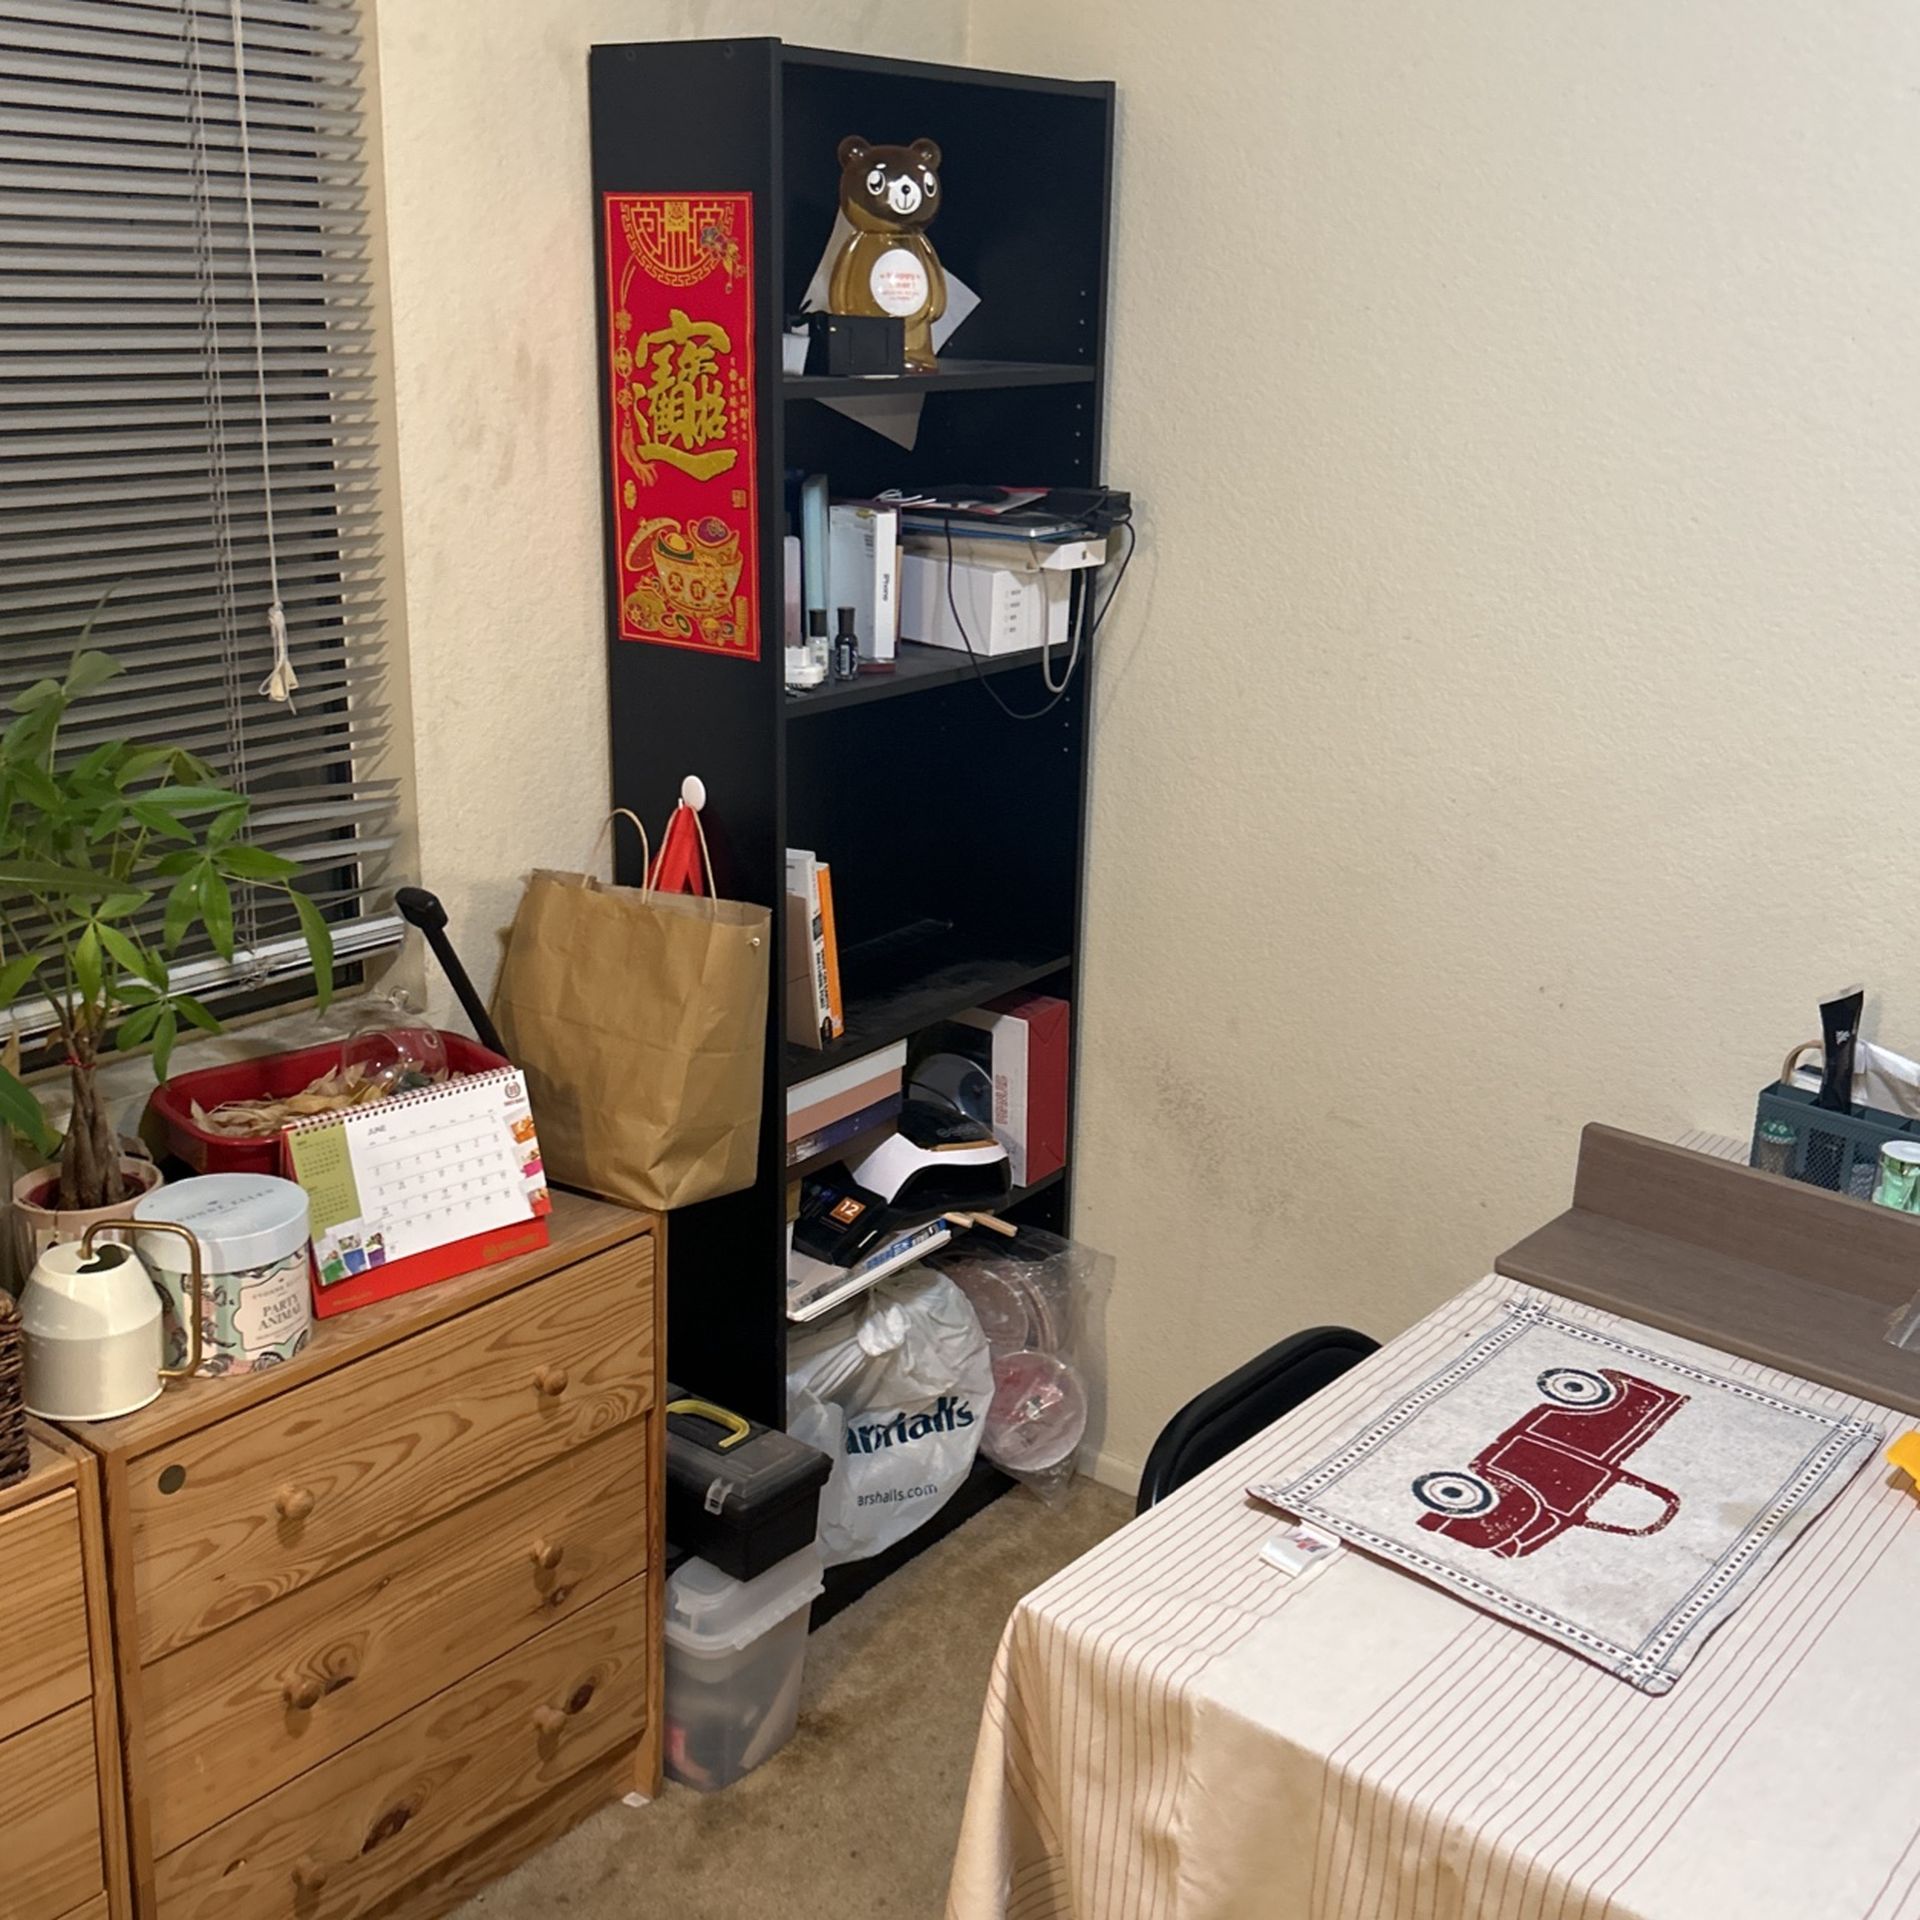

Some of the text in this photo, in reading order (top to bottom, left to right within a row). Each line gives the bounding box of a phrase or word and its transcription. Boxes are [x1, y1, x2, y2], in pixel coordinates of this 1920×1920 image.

[367, 1124, 387, 1137] JUNE
[840, 1200, 860, 1217] 12
[262, 1293, 299, 1318] PARTY
